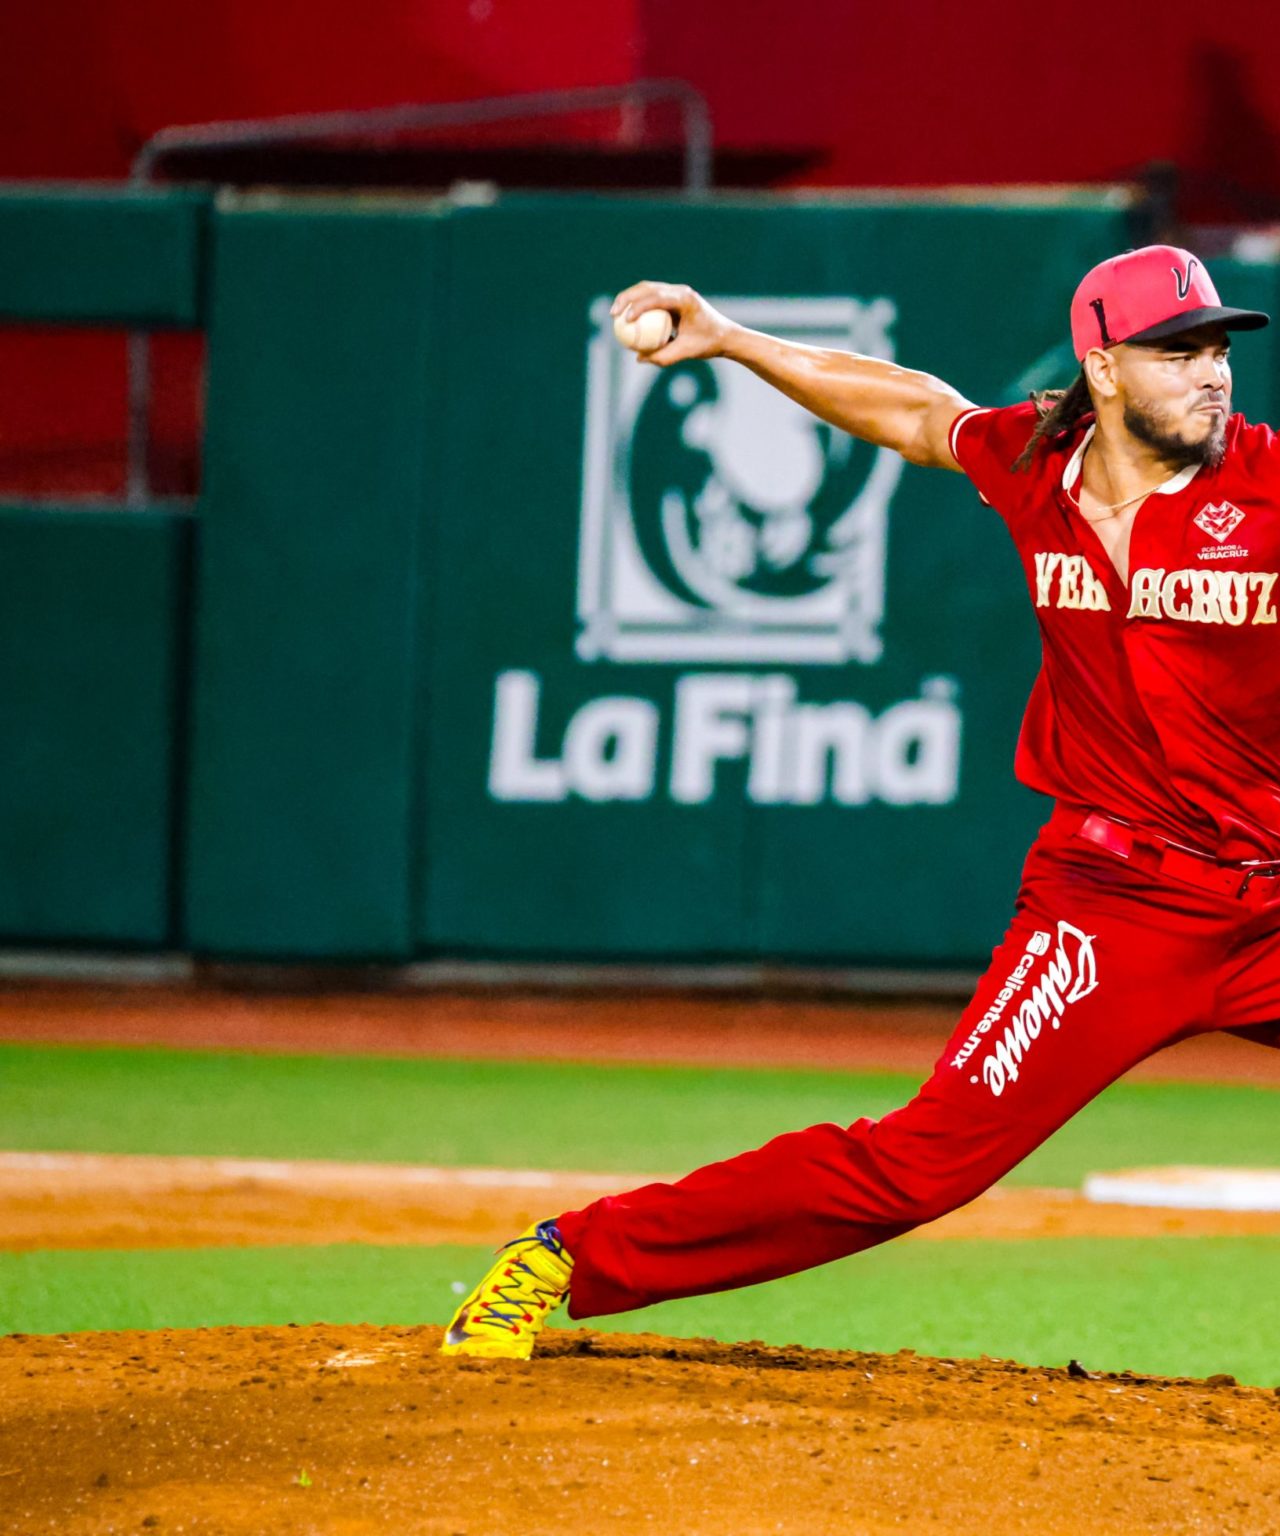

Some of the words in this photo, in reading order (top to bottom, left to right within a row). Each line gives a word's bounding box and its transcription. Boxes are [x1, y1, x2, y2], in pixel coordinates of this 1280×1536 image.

[1171, 259, 1197, 300] V
[1197, 549, 1249, 560] VERACRUZ
[488, 669, 657, 802] La
[670, 671, 962, 805] Fina
[950, 954, 1034, 1070] caliente.mx
[983, 920, 1100, 1097] Caliente
